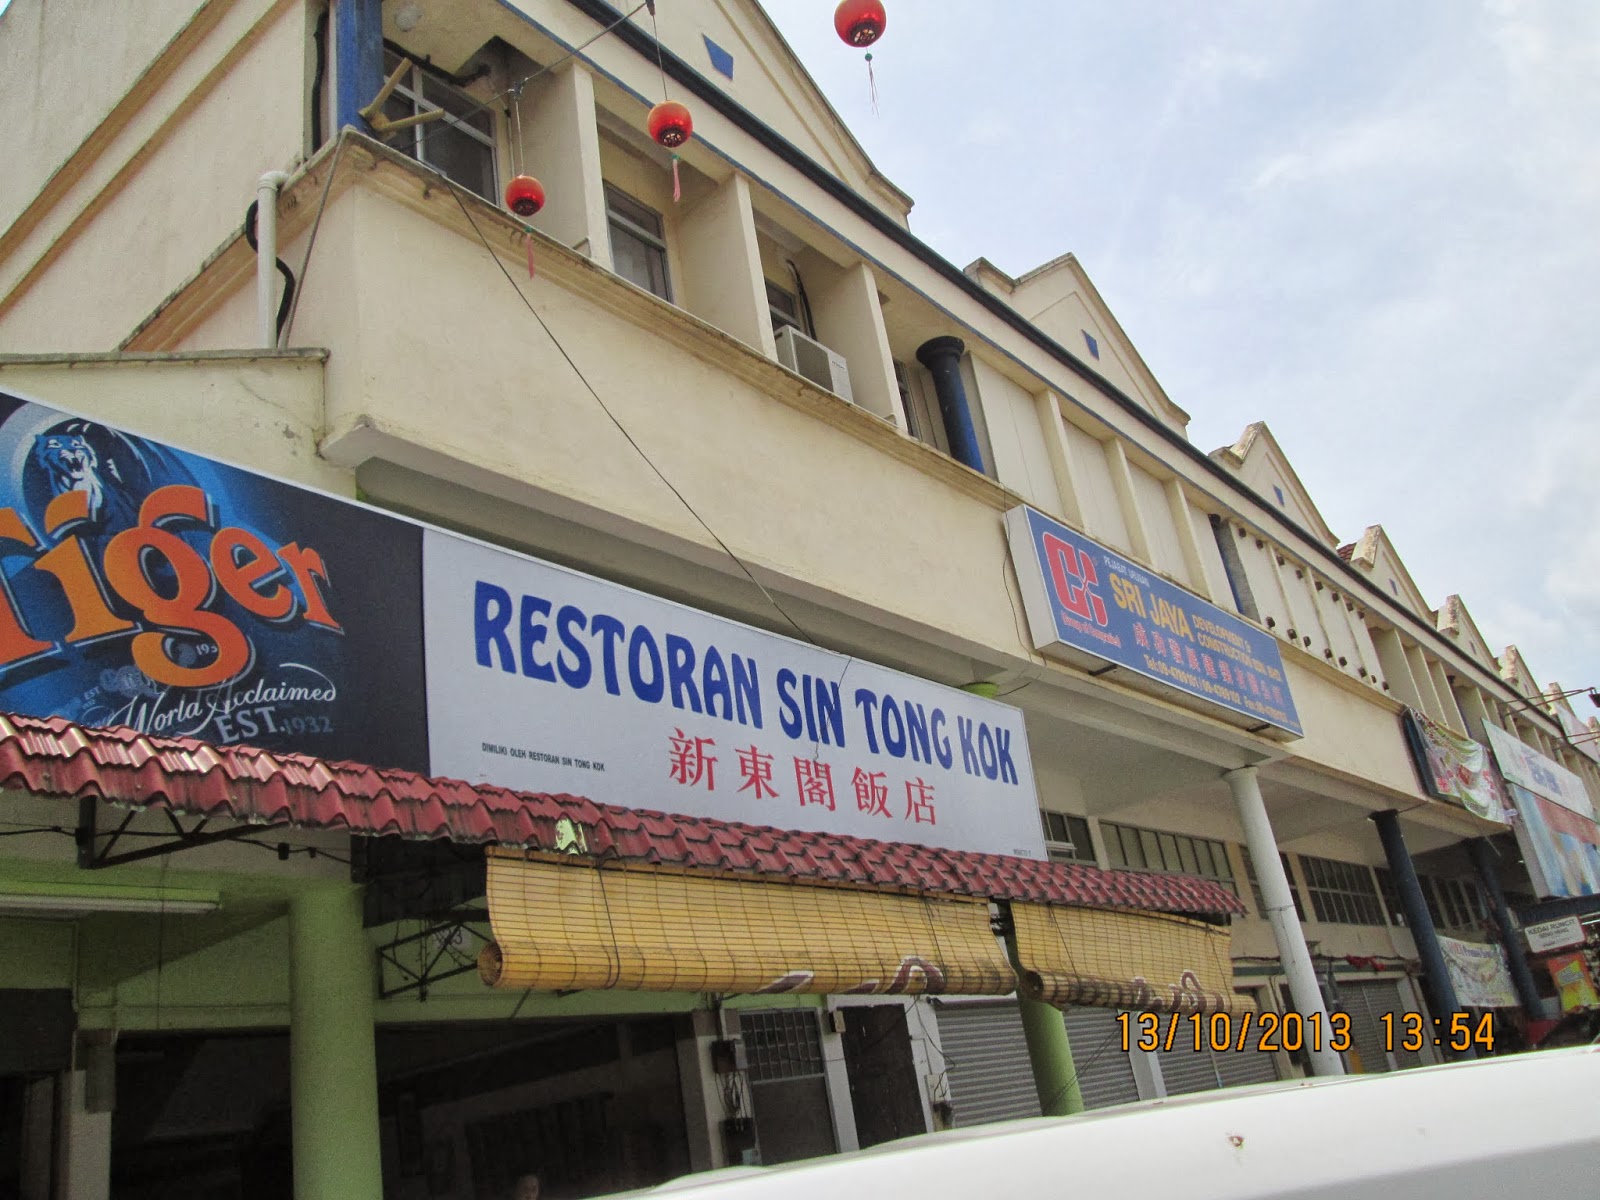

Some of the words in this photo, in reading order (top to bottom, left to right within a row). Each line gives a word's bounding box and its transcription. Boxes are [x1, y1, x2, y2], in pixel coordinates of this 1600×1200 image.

[1109, 572, 1147, 619] SRI
[1149, 592, 1195, 643] JAYA
[192, 664, 336, 731] Acclaimed
[474, 580, 763, 730] RESTORAN
[776, 668, 845, 748] SIN
[855, 688, 953, 770] TONG
[957, 715, 1019, 785] KOK
[509, 747, 526, 759] OLEH
[528, 751, 560, 765] RESTORAN
[561, 756, 573, 767] SIN
[574, 758, 590, 770] TONG
[592, 761, 605, 772] KOK
[668, 726, 936, 826] 新東閣飯店
